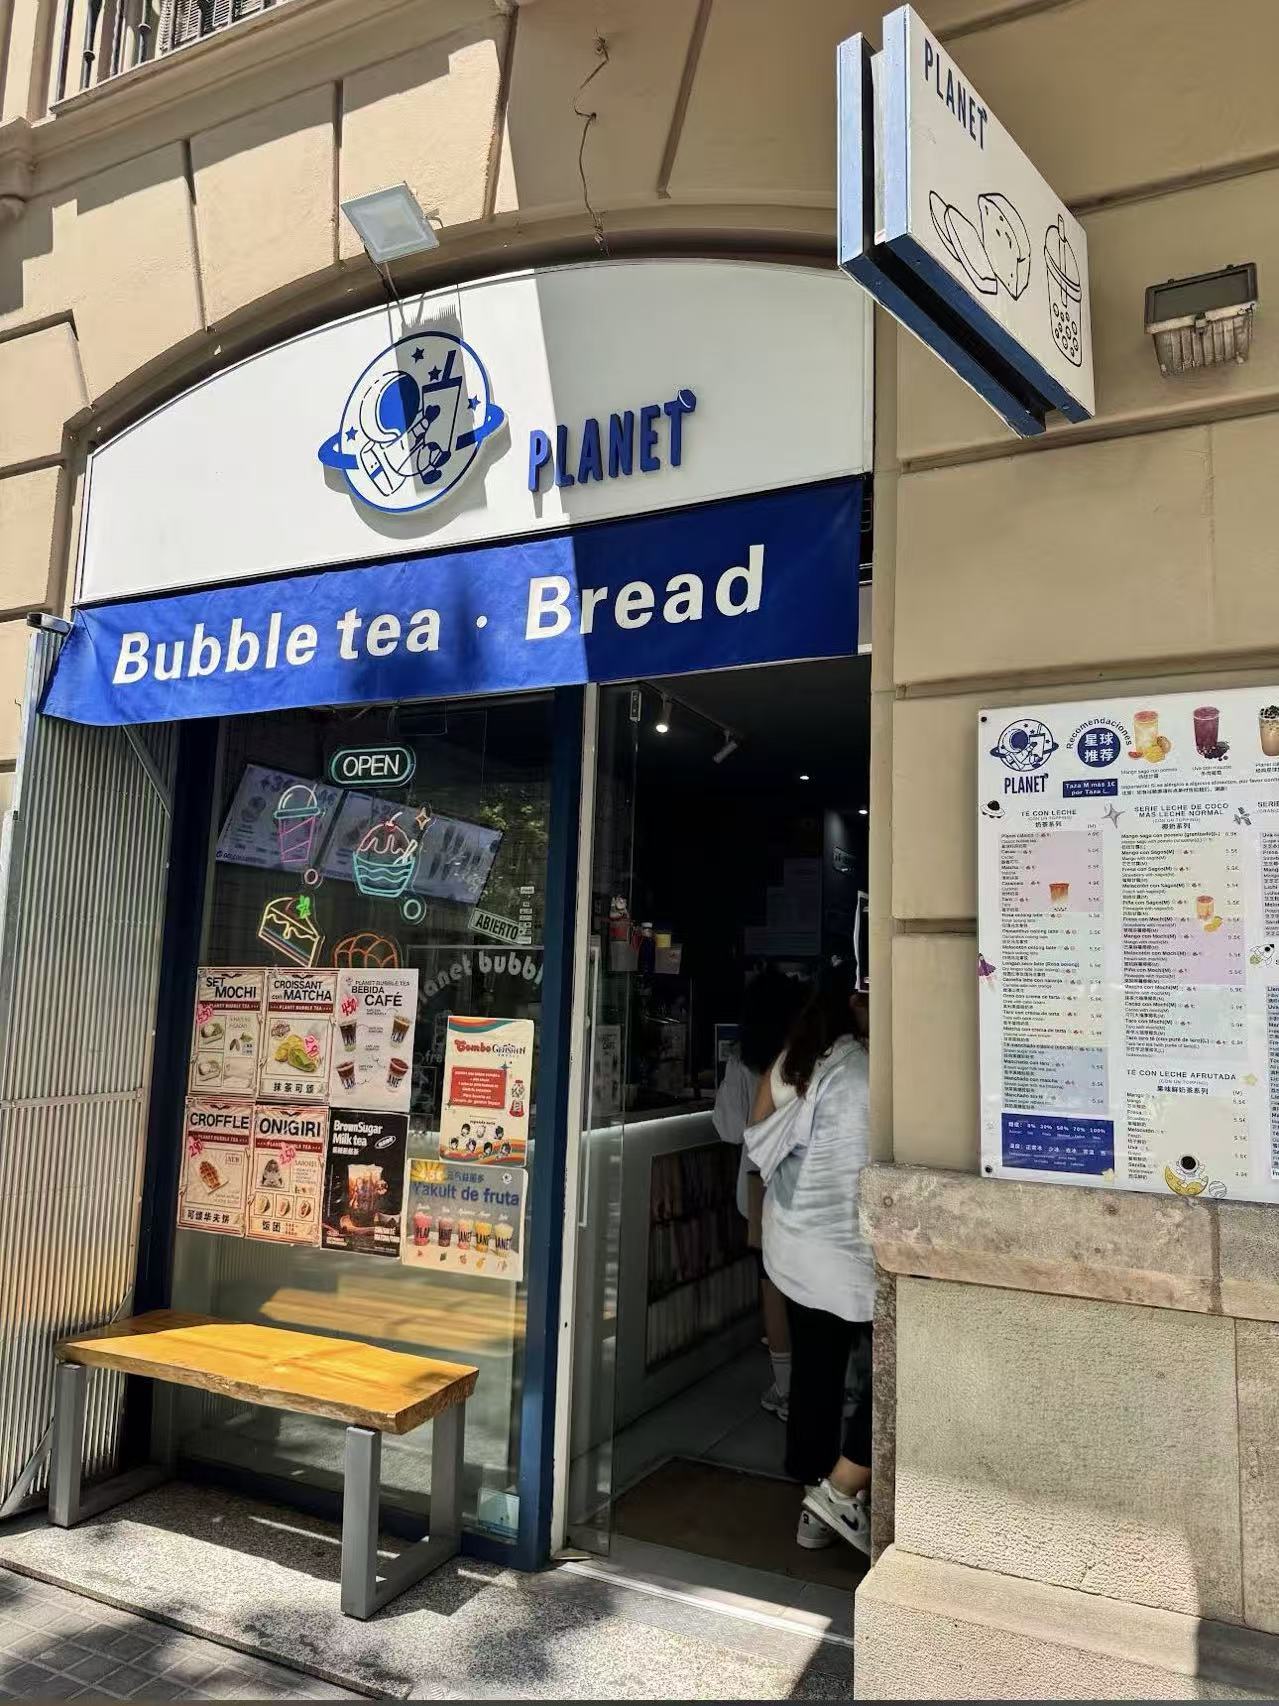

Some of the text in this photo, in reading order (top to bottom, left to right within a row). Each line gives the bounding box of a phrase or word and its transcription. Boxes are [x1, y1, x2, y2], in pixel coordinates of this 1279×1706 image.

[924, 38, 989, 150] PLANET
[527, 388, 697, 492] PLANET
[112, 611, 318, 685] Bubble
[335, 608, 440, 660] tea
[524, 543, 765, 641] Bread
[1066, 717, 1133, 749] Recomendaciones
[1084, 732, 1114, 747] 星球
[1084, 748, 1114, 763] 推荐
[343, 754, 400, 777] OPEN
[1004, 772, 1049, 795] PLANET
[1204, 802, 1229, 810] COCO
[475, 914, 519, 940] ABIERTO
[206, 977, 226, 987] SET
[423, 952, 472, 997] anet
[214, 986, 257, 998] MOCHI
[274, 980, 323, 990] CROISSANT
[351, 986, 385, 994] BEBIDA
[284, 989, 332, 1001] MATCHA
[364, 992, 403, 1007] CAFÉ
[454, 1039, 491, 1053] Combo
[1190, 1072, 1236, 1080] AFRUTADA
[190, 1112, 249, 1129] CROFFLE
[259, 1117, 321, 1138] ONIGIRI
[333, 1119, 383, 1137] BrownSugar
[332, 1132, 368, 1147] Milk tea
[412, 1183, 520, 1206] Yakult de fruta
